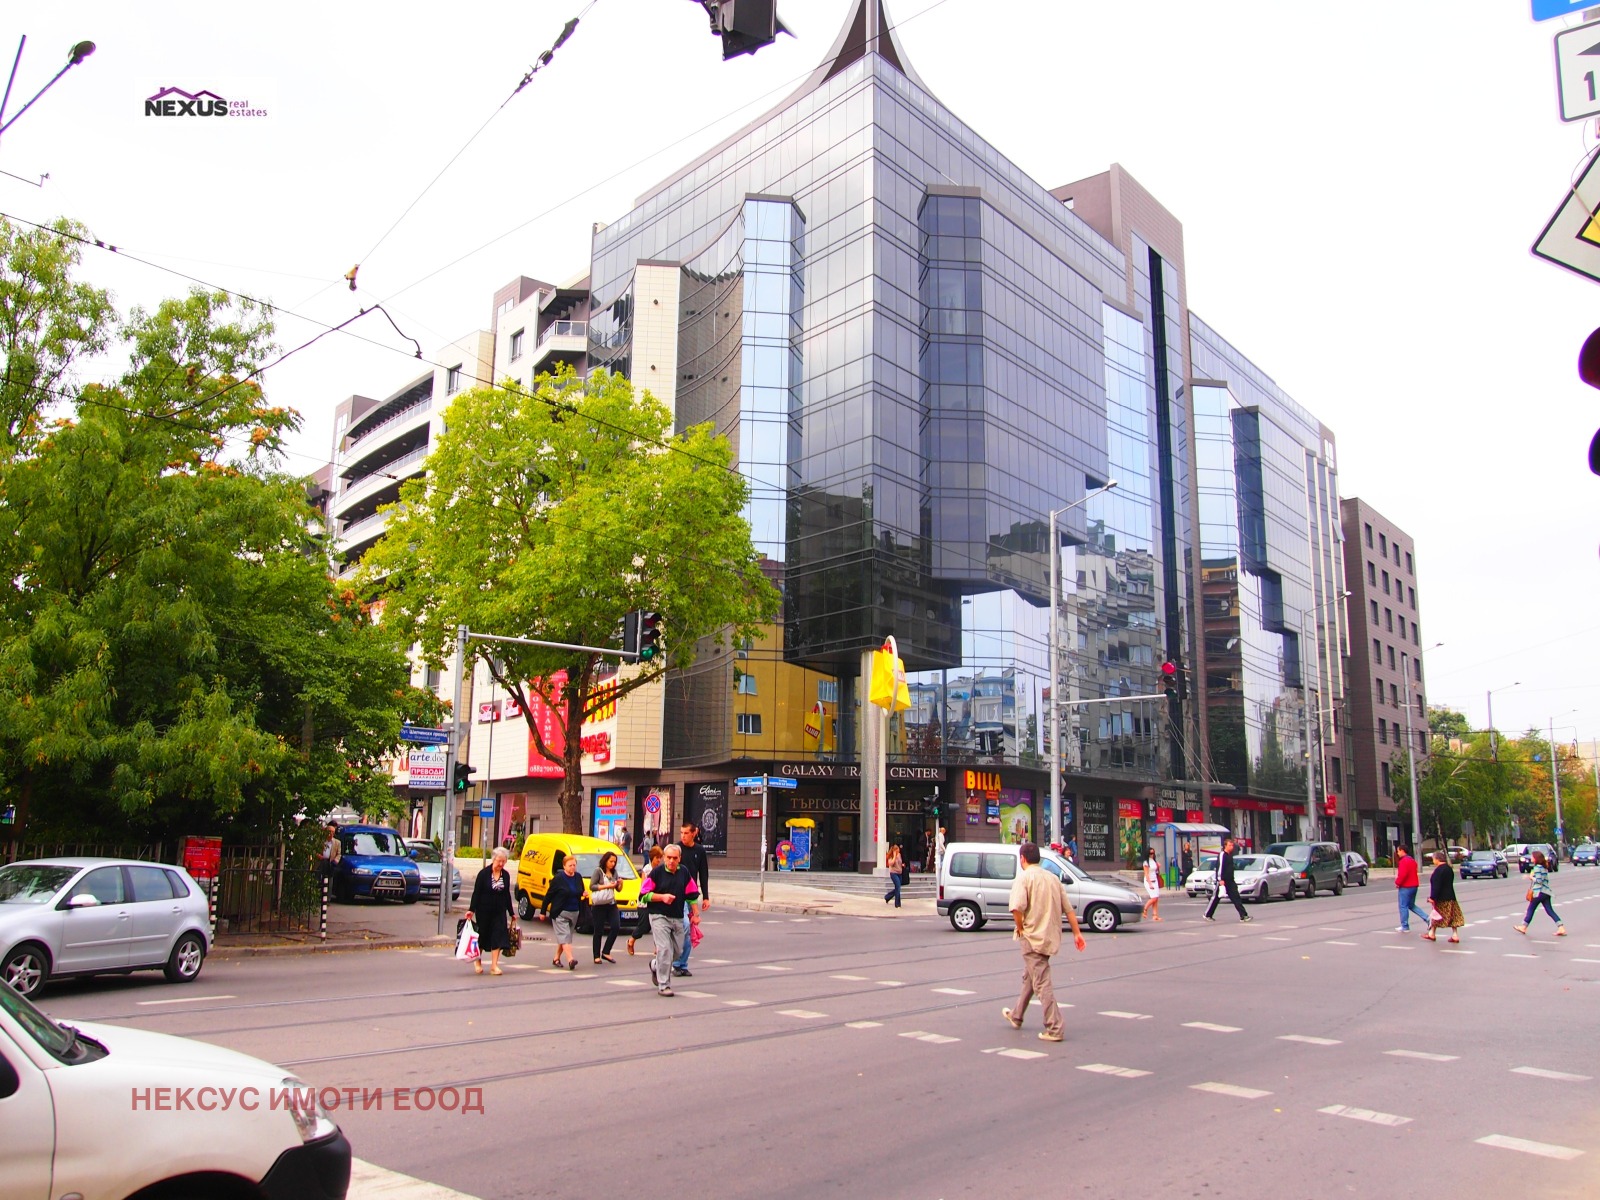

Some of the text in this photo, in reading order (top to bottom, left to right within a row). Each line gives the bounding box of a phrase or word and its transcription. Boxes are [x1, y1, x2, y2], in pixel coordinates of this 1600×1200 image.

[782, 764, 835, 776] GALAXY
[890, 767, 939, 778] CENTER
[965, 770, 1002, 791] BILLA
